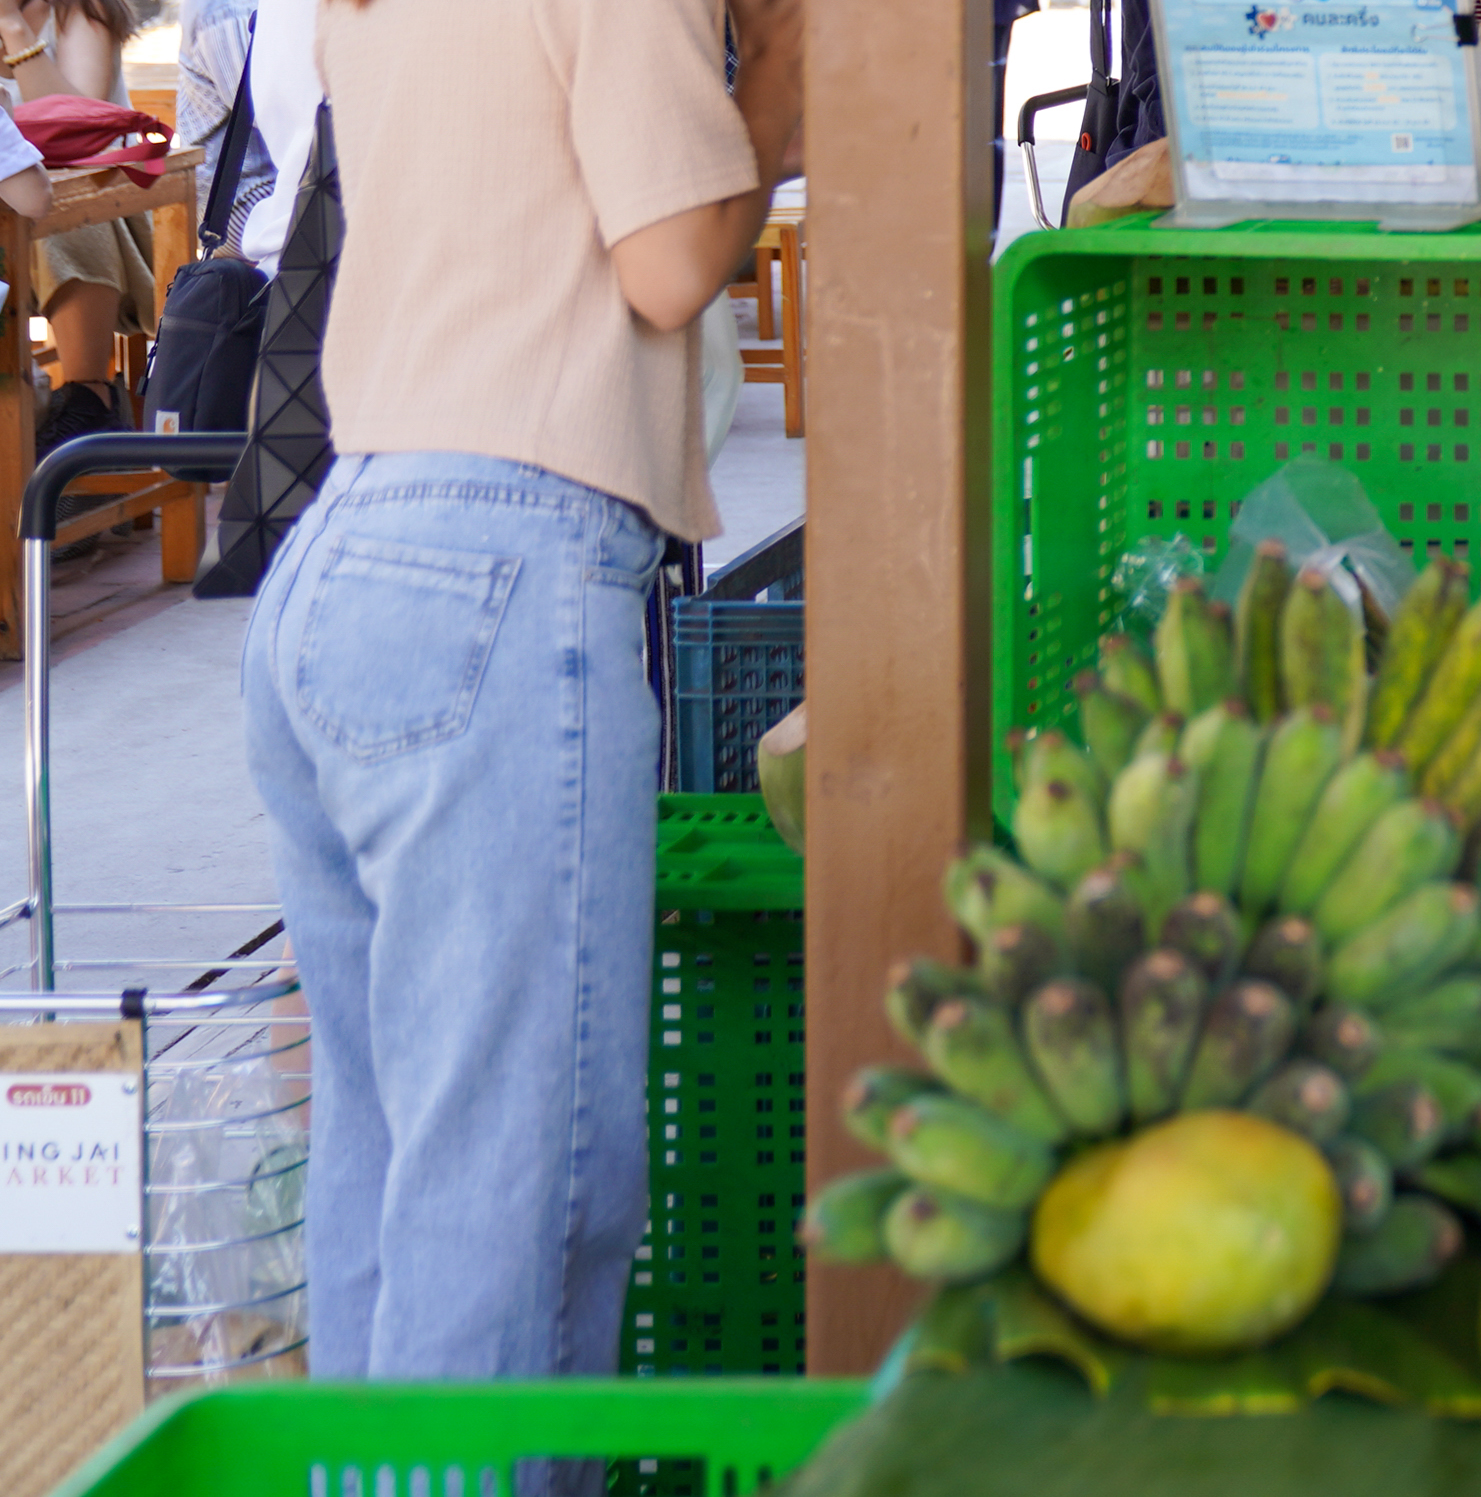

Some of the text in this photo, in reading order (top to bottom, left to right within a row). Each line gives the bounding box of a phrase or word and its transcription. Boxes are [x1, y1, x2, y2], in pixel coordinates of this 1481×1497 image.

[1303, 6, 1380, 29] คนละครึ่ง
[3, 1141, 119, 1161] ING JAI
[6, 1166, 124, 1185] ARKET
